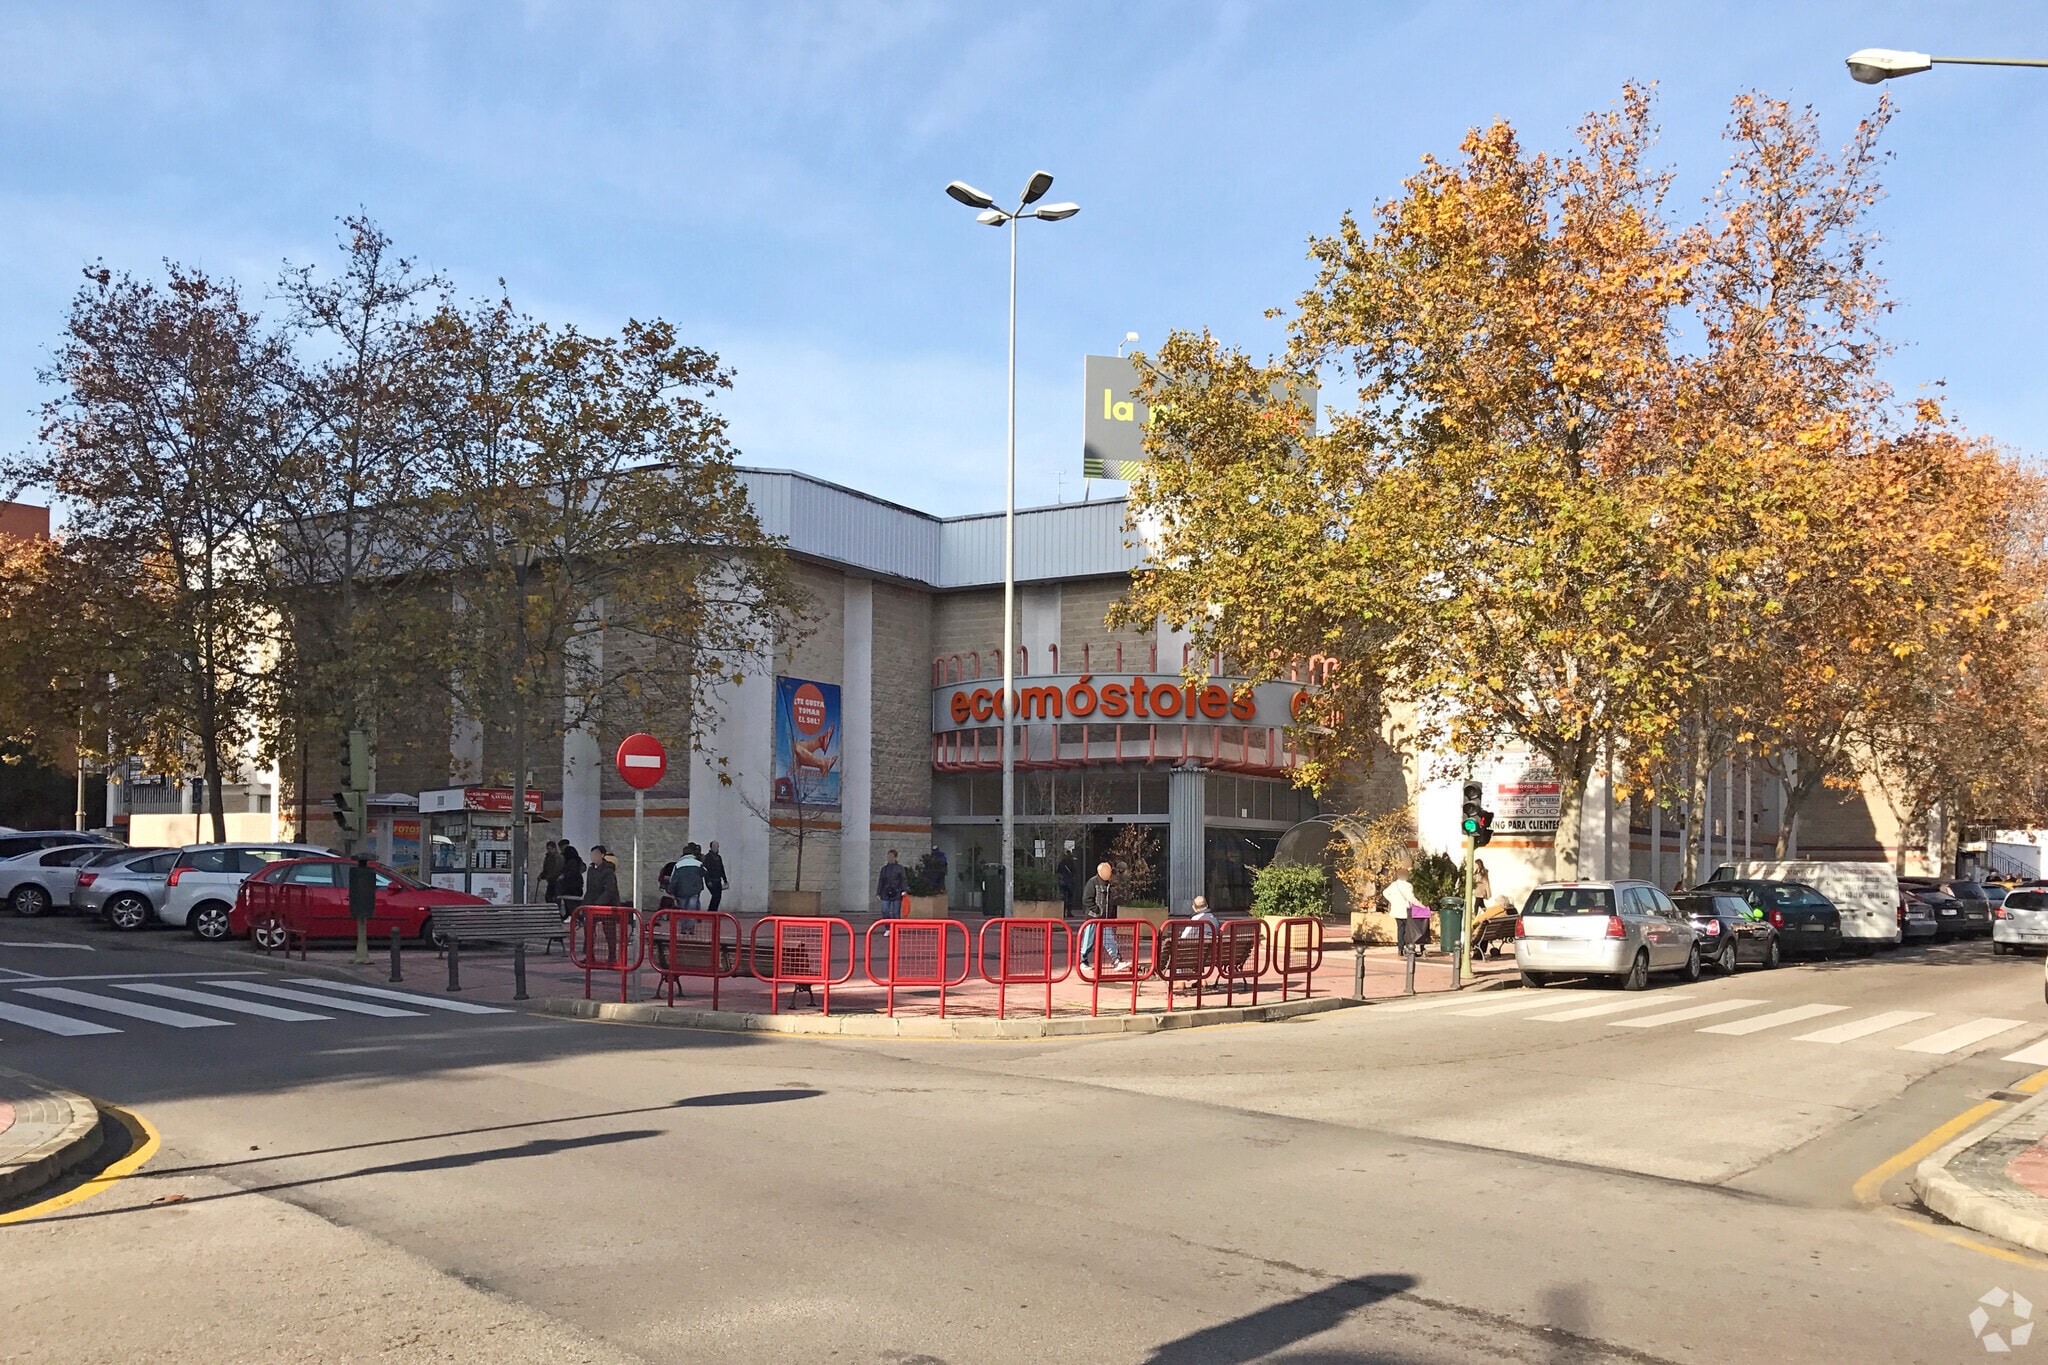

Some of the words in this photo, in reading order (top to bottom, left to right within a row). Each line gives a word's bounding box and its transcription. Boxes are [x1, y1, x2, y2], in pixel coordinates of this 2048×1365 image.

[1104, 389, 1134, 421] la
[805, 699, 825, 708] GUSTA
[951, 675, 1257, 723] ecomóstoles
[798, 707, 820, 716] TOMAR
[1508, 820, 1527, 829] PARA
[1528, 819, 1560, 830] CLIENTES
